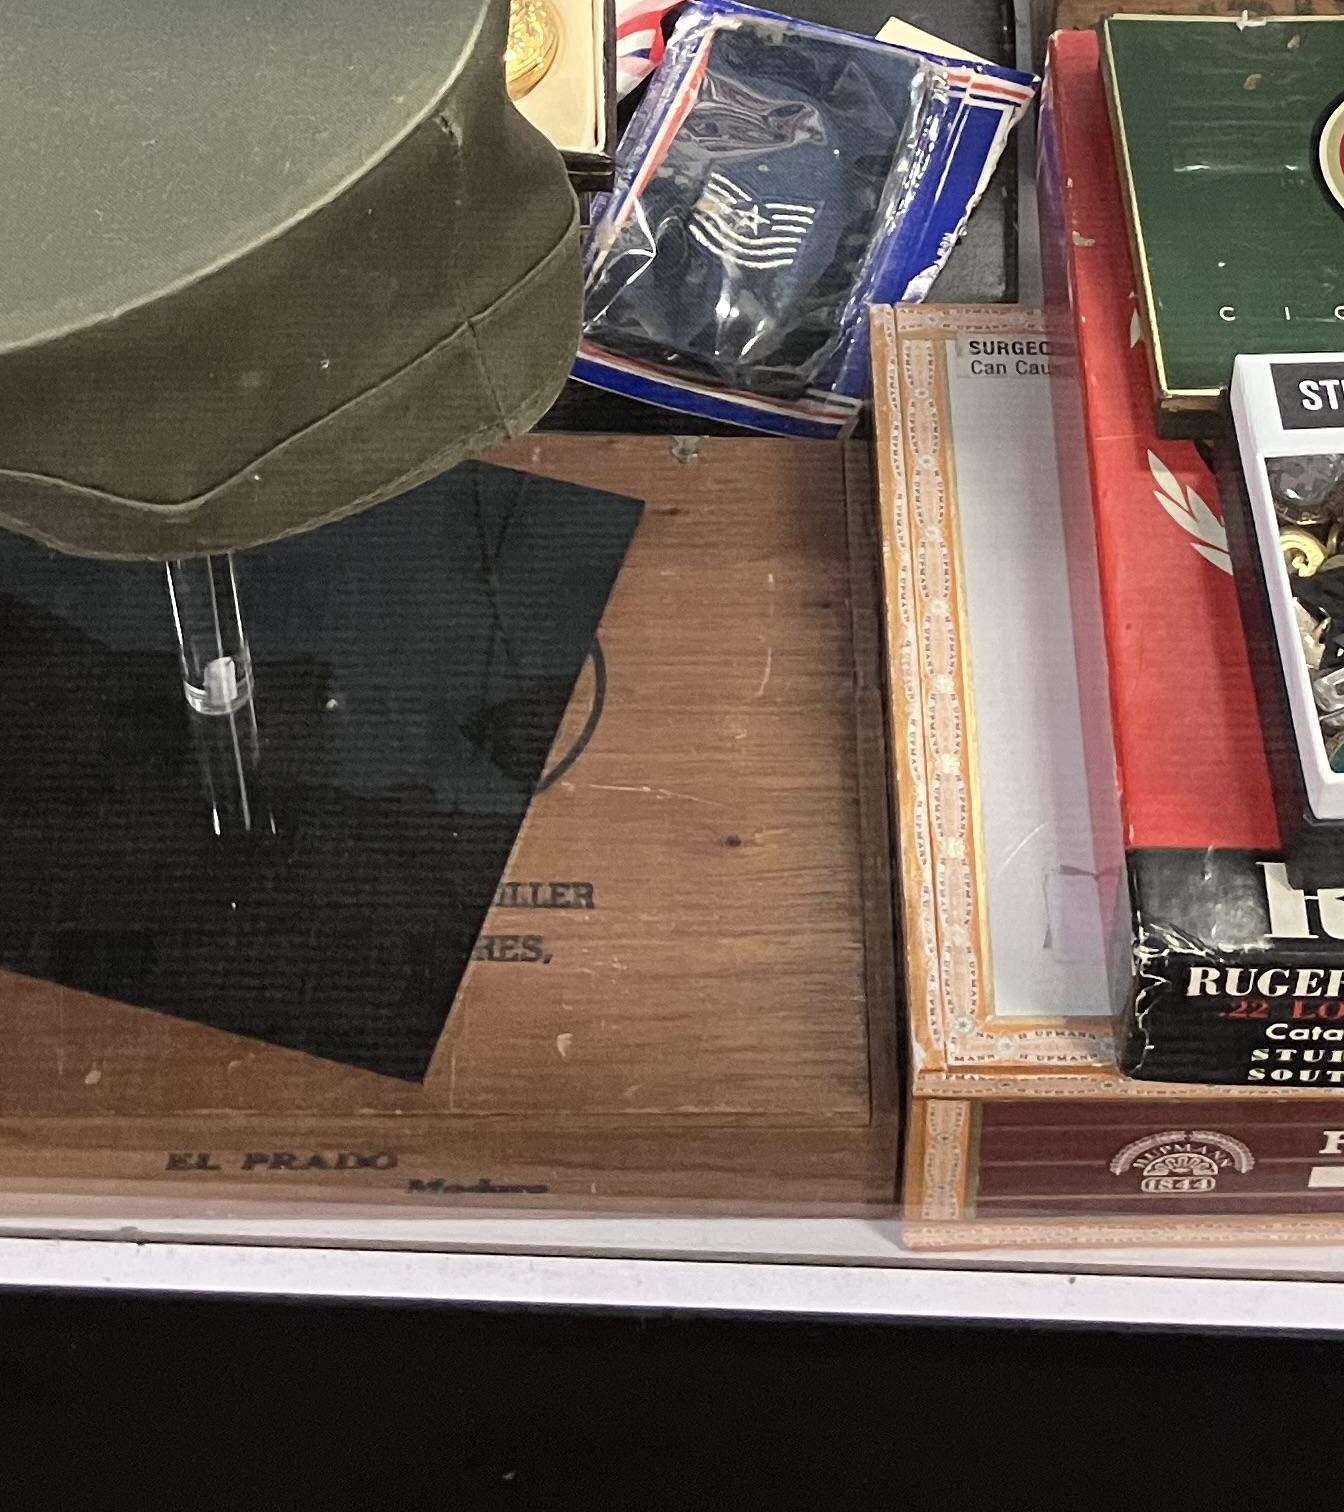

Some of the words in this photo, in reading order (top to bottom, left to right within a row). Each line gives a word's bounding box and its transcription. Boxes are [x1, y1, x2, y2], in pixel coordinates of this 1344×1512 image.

[971, 359, 1007, 375] Can
[1218, 1000, 1270, 1020] .22
[165, 1152, 221, 1171] EL
[242, 1150, 399, 1171] PRADO
[1146, 1178, 1207, 1190] 1844
